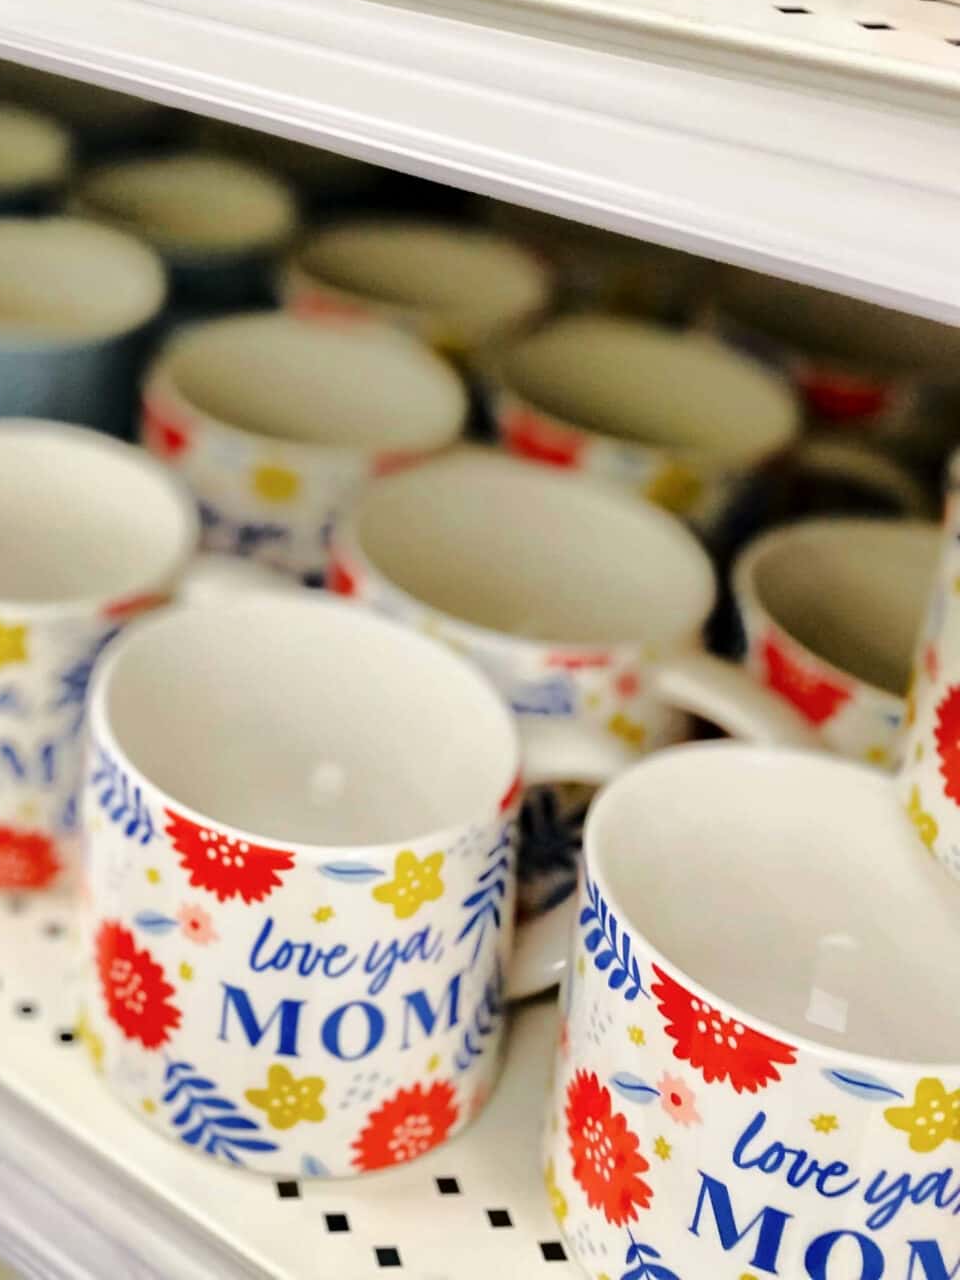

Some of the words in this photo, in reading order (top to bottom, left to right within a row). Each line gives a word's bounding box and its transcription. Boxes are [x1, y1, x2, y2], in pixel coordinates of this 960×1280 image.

[248, 917, 358, 979] love
[216, 972, 464, 1062] MOM
[732, 1111, 860, 1197] love
[688, 1169, 960, 1280] MO
